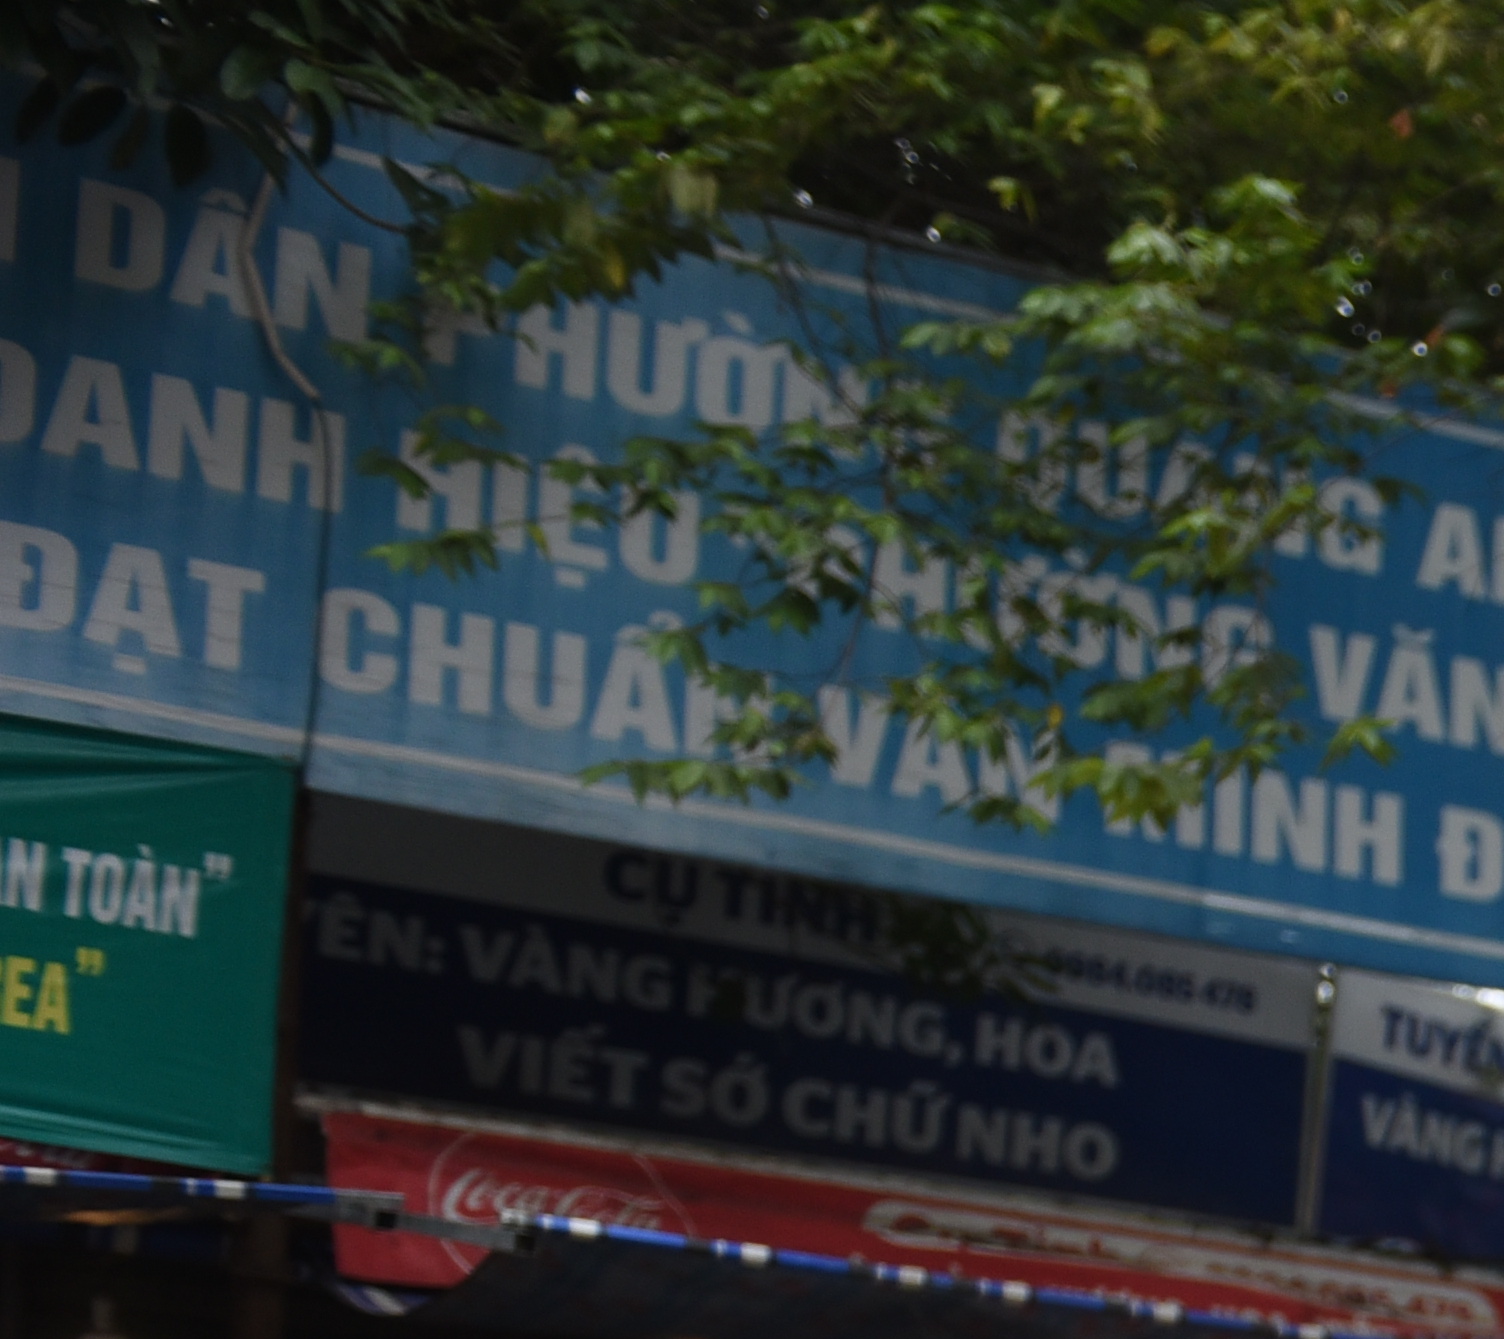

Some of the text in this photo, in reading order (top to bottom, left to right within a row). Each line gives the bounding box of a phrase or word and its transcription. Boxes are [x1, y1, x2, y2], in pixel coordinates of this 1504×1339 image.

[75, 177, 372, 345] DÂN
[422, 285, 958, 475] HƯỜN
[0, 519, 266, 674] ĐẠT
[0, 837, 47, 912] N
[0, 946, 105, 1034] EA”
[301, 890, 446, 975] ÊN:
[460, 922, 673, 1011] VÀNG
[974, 1010, 1121, 1090] HOA
[457, 1022, 650, 1111] VIẾT
[782, 1072, 950, 1166] CHỮ
[955, 1104, 1120, 1182] NHO
